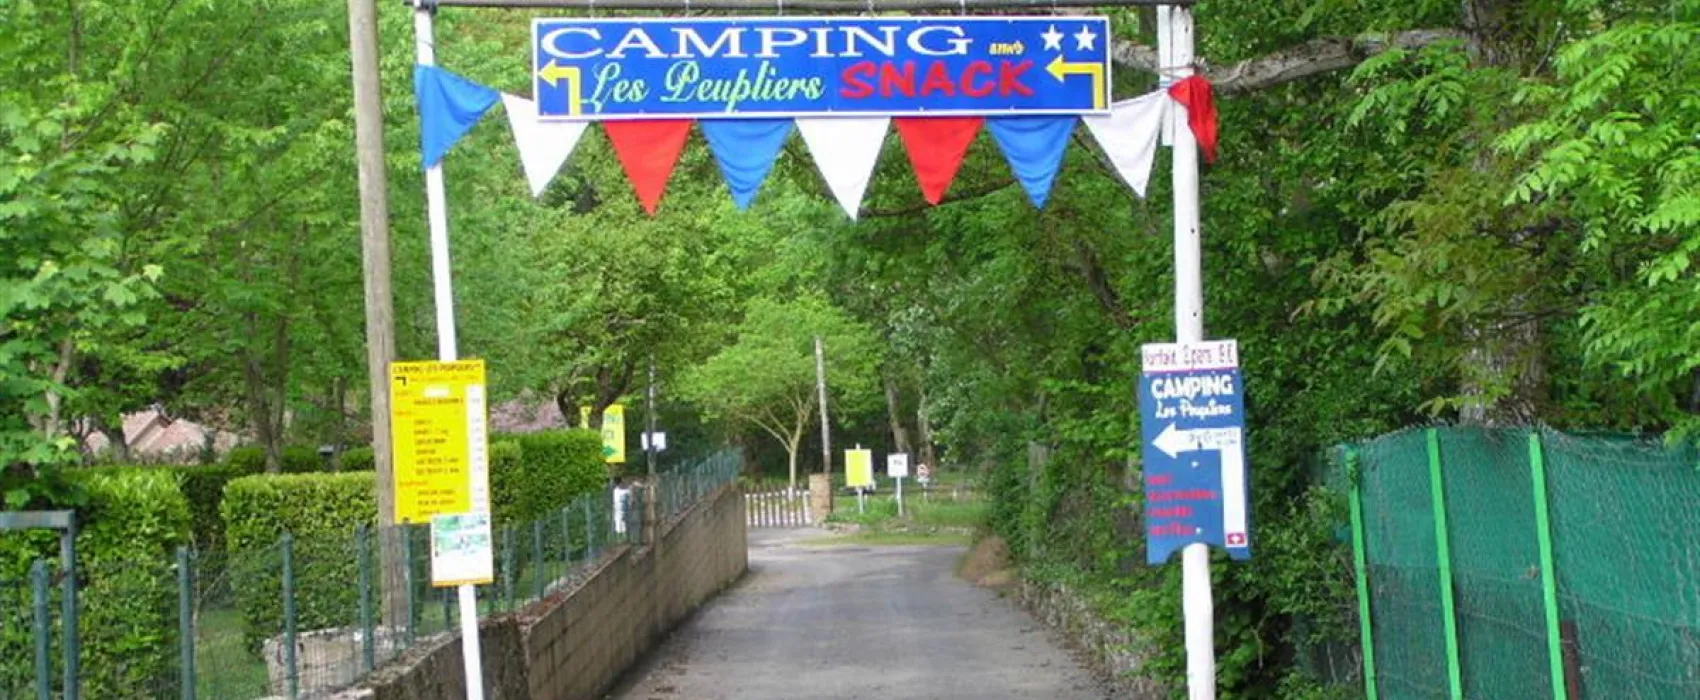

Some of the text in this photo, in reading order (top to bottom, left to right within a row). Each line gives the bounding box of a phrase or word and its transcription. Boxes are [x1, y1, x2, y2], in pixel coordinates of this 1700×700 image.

[541, 26, 973, 58] CAMPING
[581, 59, 1035, 113] Les Peupliers SNACK
[1151, 374, 1234, 400] CAMPING
[1155, 399, 1177, 418] Les
